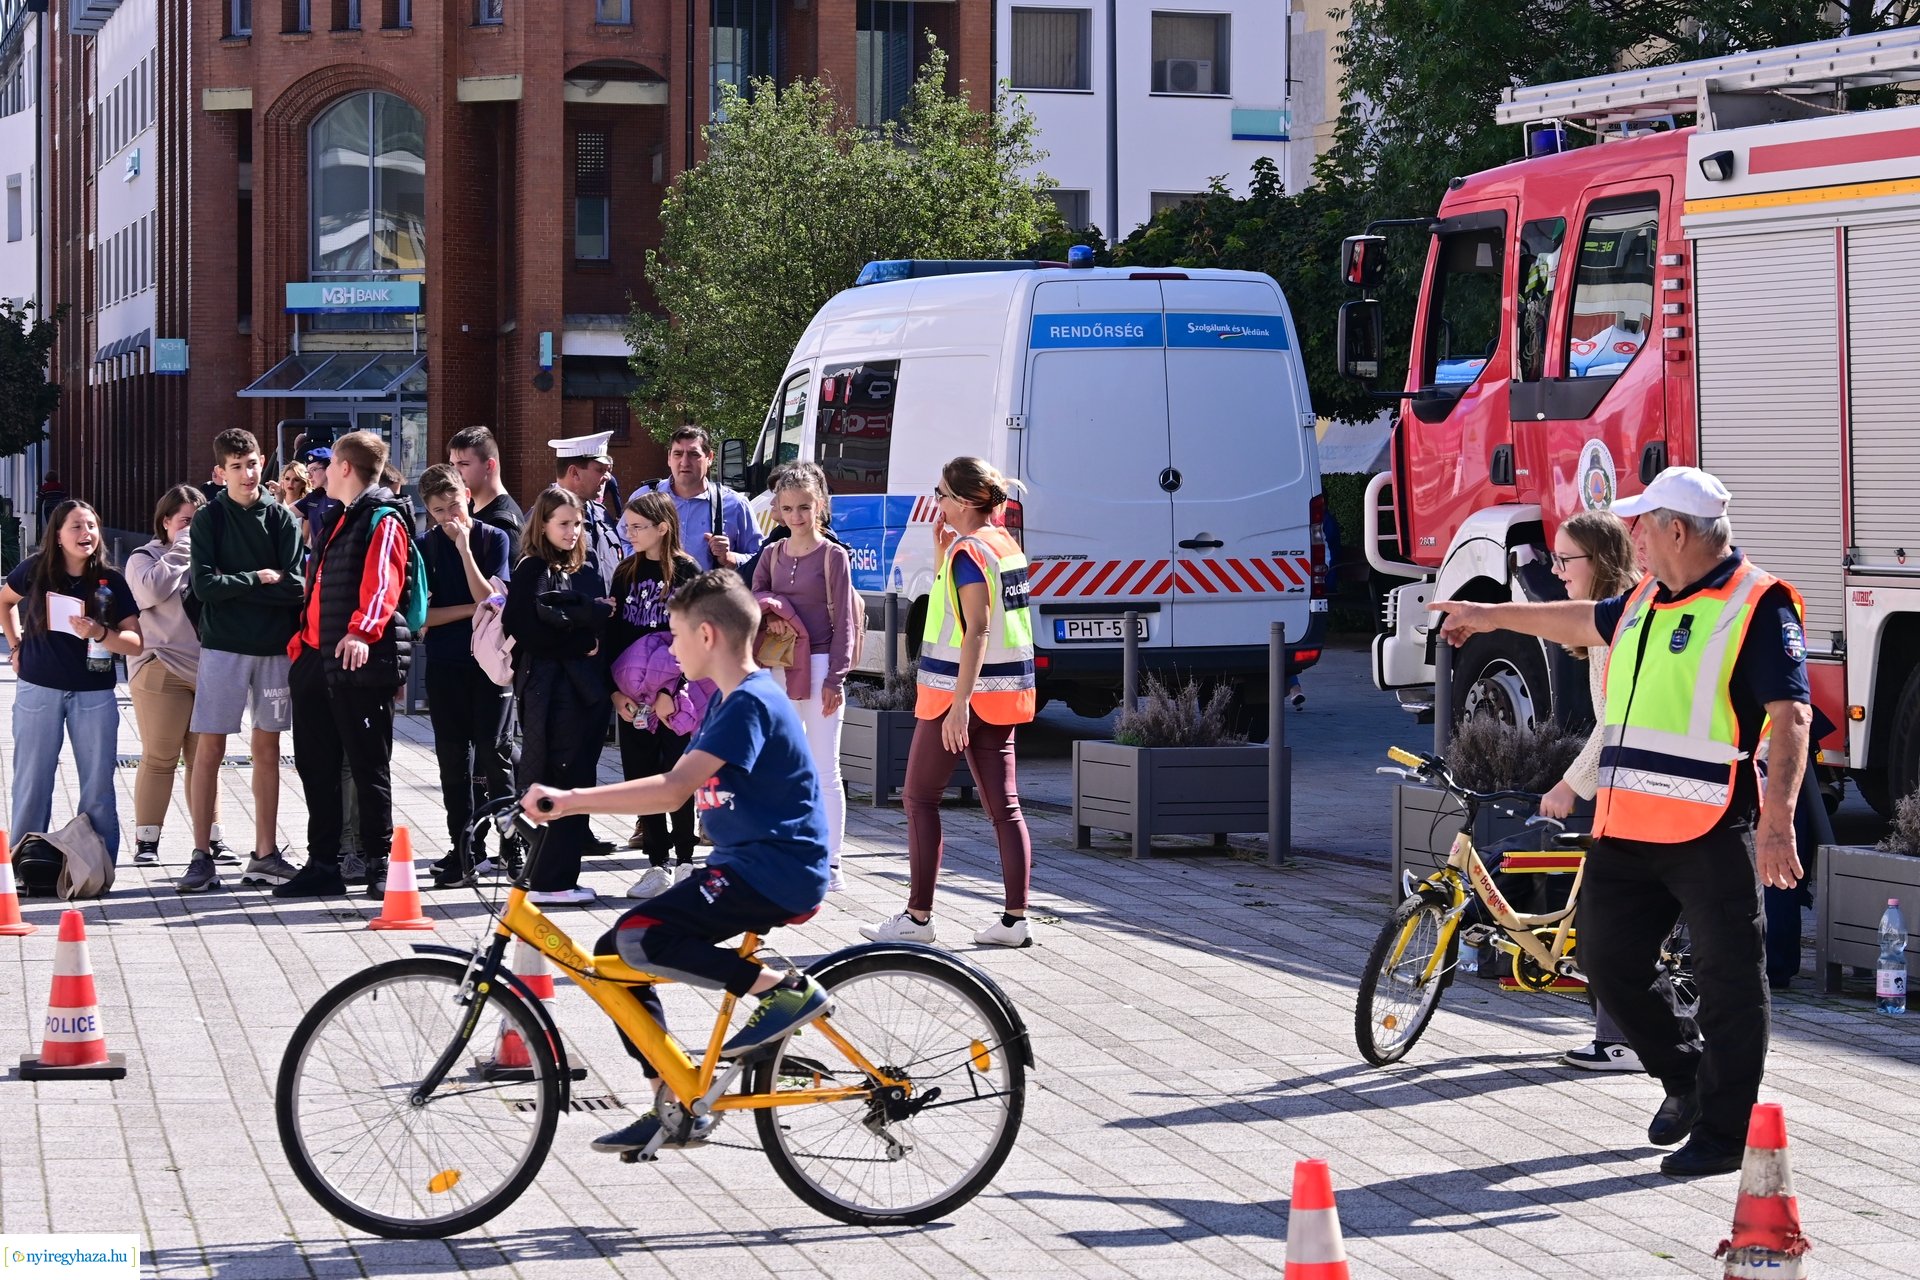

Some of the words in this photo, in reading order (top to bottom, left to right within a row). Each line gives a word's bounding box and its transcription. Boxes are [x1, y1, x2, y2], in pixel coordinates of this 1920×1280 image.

[322, 287, 356, 304] MBH
[357, 288, 391, 302] BANK
[1050, 322, 1144, 338] RENDŐRSÉG
[1232, 324, 1241, 333] és
[1068, 621, 1144, 637] PHT-59
[46, 1015, 96, 1034] POLICE
